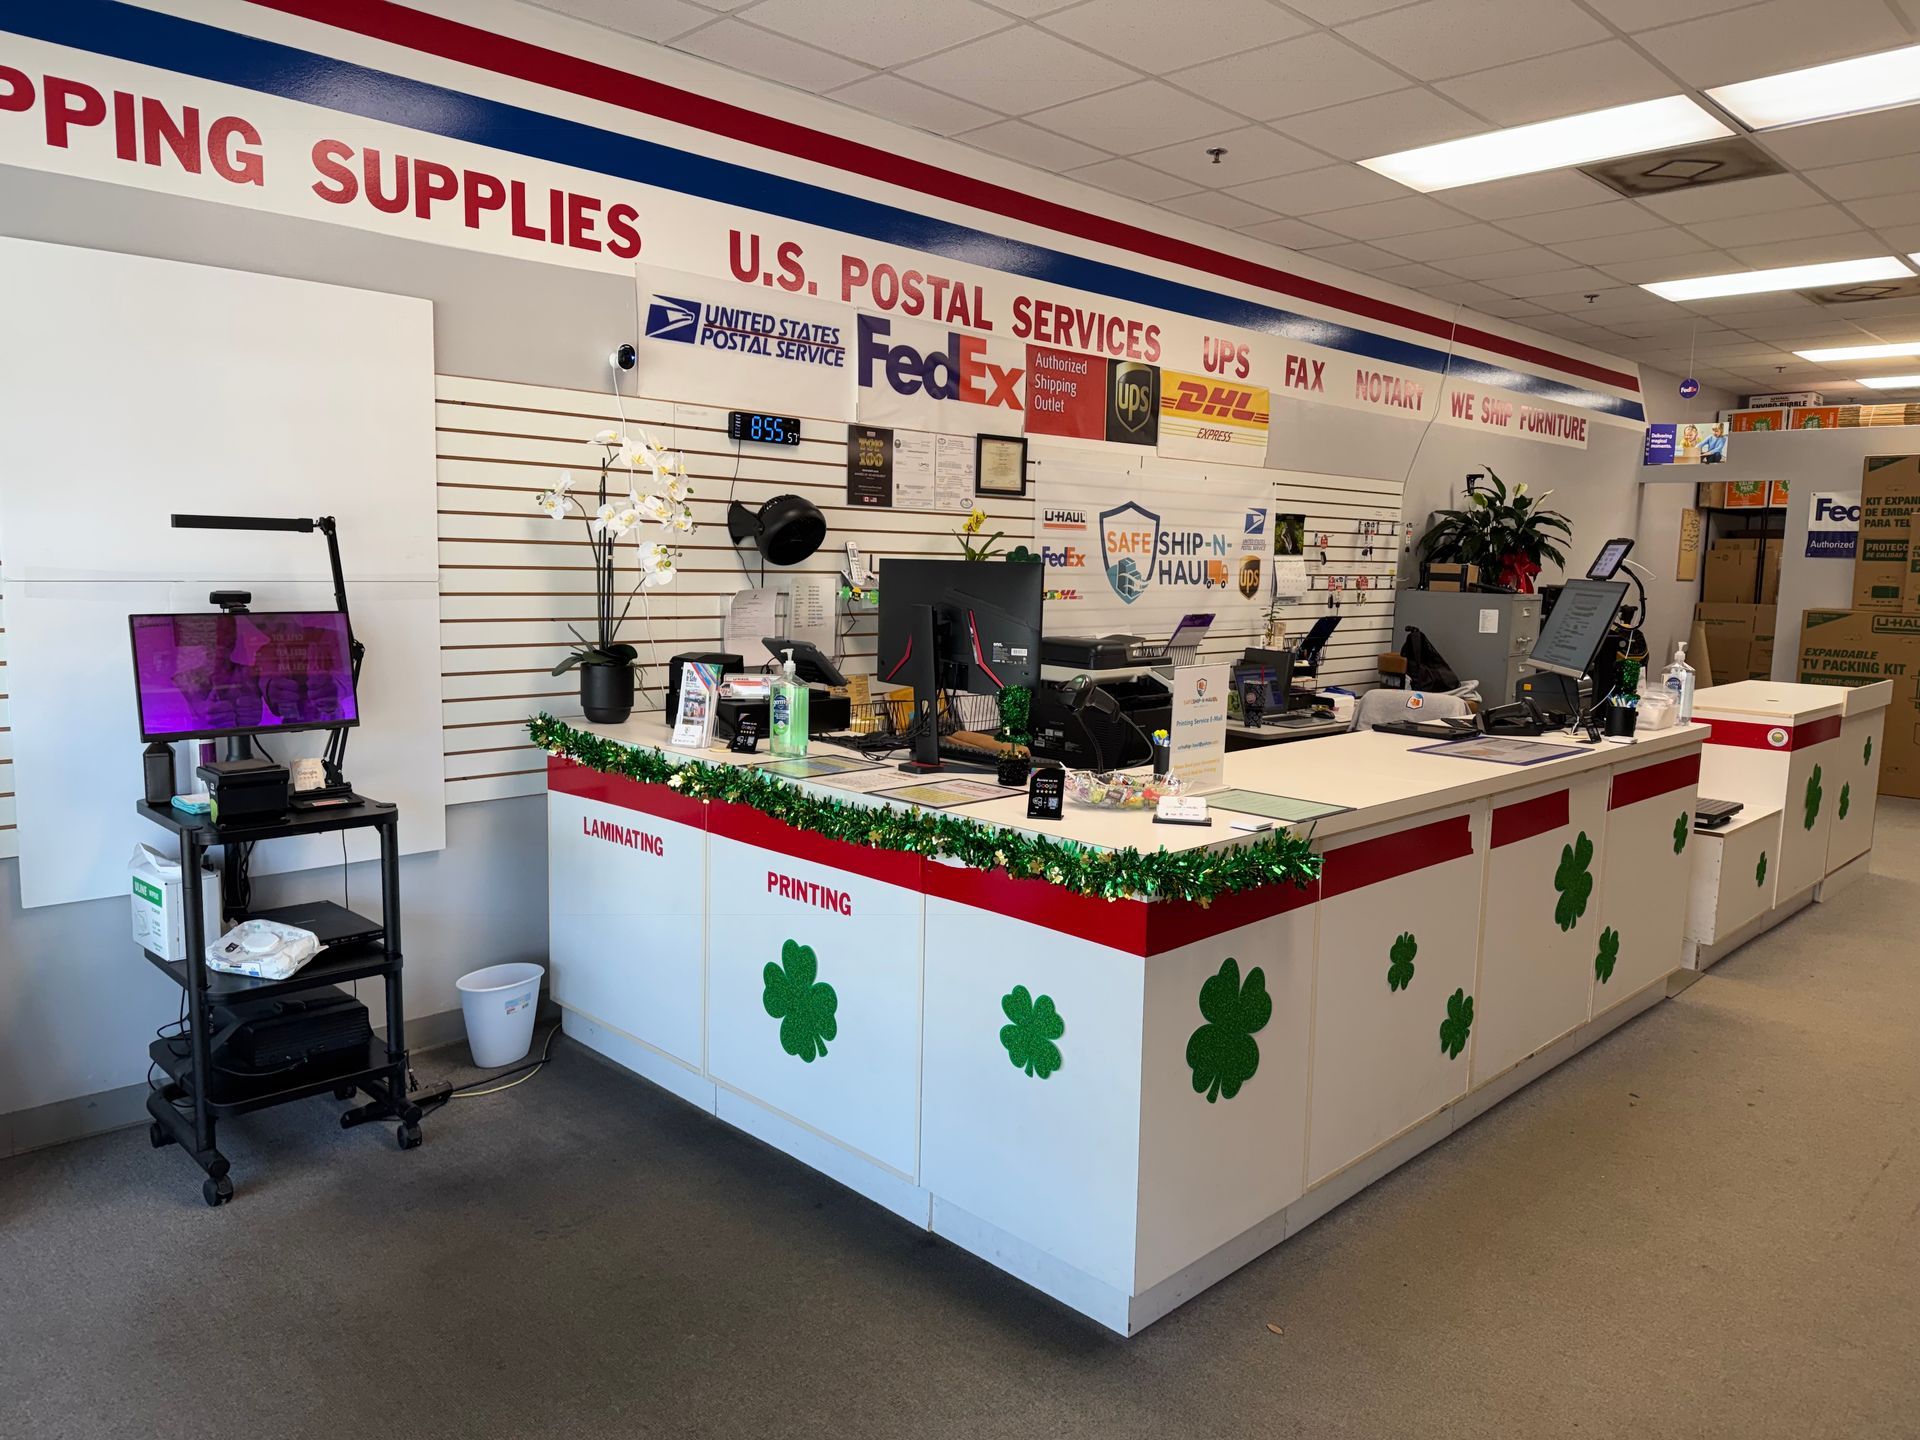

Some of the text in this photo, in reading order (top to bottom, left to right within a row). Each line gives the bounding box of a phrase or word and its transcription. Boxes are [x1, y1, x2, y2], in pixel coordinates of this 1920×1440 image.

[311, 138, 642, 259] SUPPLIES
[729, 229, 1161, 362] U.S. POSTAL SERVICES
[705, 304, 840, 345] UNITED STATES
[700, 328, 846, 368] POSTAL SERVICE
[1203, 335, 1251, 379] UPS
[858, 314, 1025, 411] FedEx
[1035, 353, 1088, 375] Authorized
[1284, 354, 1326, 393] FAX
[1034, 374, 1077, 397] Shipping
[1356, 369, 1425, 411] NOTARY
[1034, 396, 1065, 413] Outlet
[1118, 383, 1149, 421] ups
[1174, 381, 1256, 422] DHL
[1451, 391, 1587, 442] WE SHIP FURNITURE
[1196, 427, 1233, 443] EXPRESS
[859, 452, 884, 467] 100
[1865, 496, 1883, 505] KIT
[1865, 507, 1879, 517] DE
[1044, 510, 1086, 523] U-HAUL
[1864, 519, 1891, 528] PARA
[1107, 531, 1152, 554] SAFE
[1158, 531, 1233, 556] SHIP-N-
[1809, 540, 1855, 549] Authorized
[1042, 546, 1085, 568] FedEx
[1158, 560, 1215, 585] HAUL
[1240, 569, 1259, 593] ups
[1804, 648, 1879, 660] EXPANDABLE
[1801, 658, 1907, 675] TV PACKING KIT
[583, 816, 664, 856] LAMINATING
[767, 871, 852, 917] PRINTING
